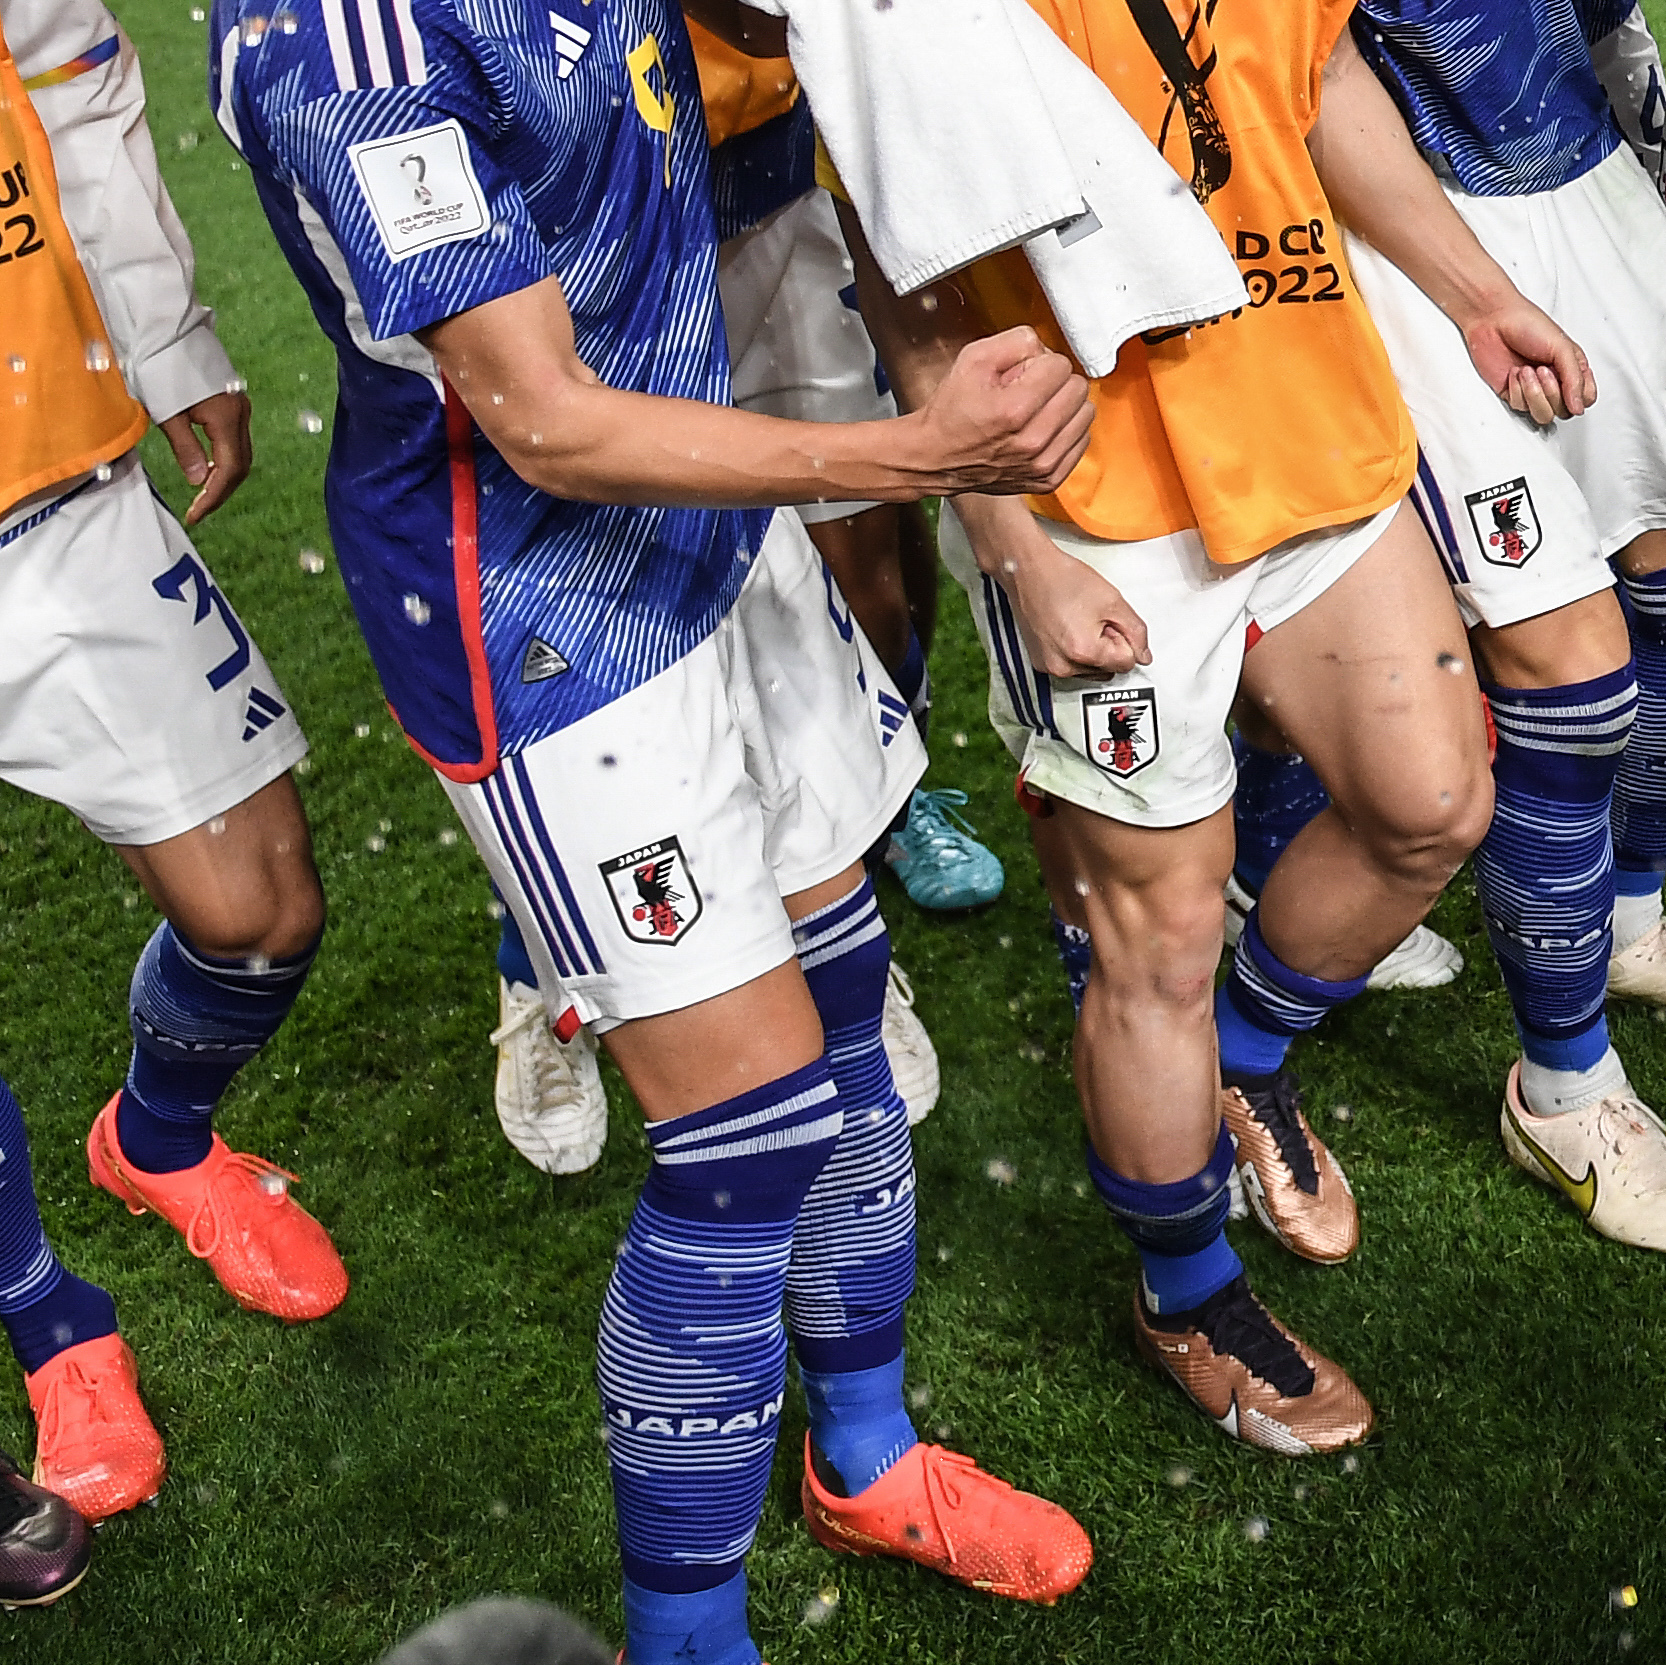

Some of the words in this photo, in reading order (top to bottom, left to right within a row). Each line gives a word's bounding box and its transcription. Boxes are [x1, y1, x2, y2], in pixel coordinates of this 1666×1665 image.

[394, 216, 412, 227] FIFA
[412, 207, 446, 221] WORLD
[446, 201, 464, 214] CUP
[1480, 482, 1515, 501] JAPAN
[1099, 690, 1139, 703] JAPAN
[618, 843, 662, 868] JAPAN
[608, 1391, 784, 1437] JAPAN
